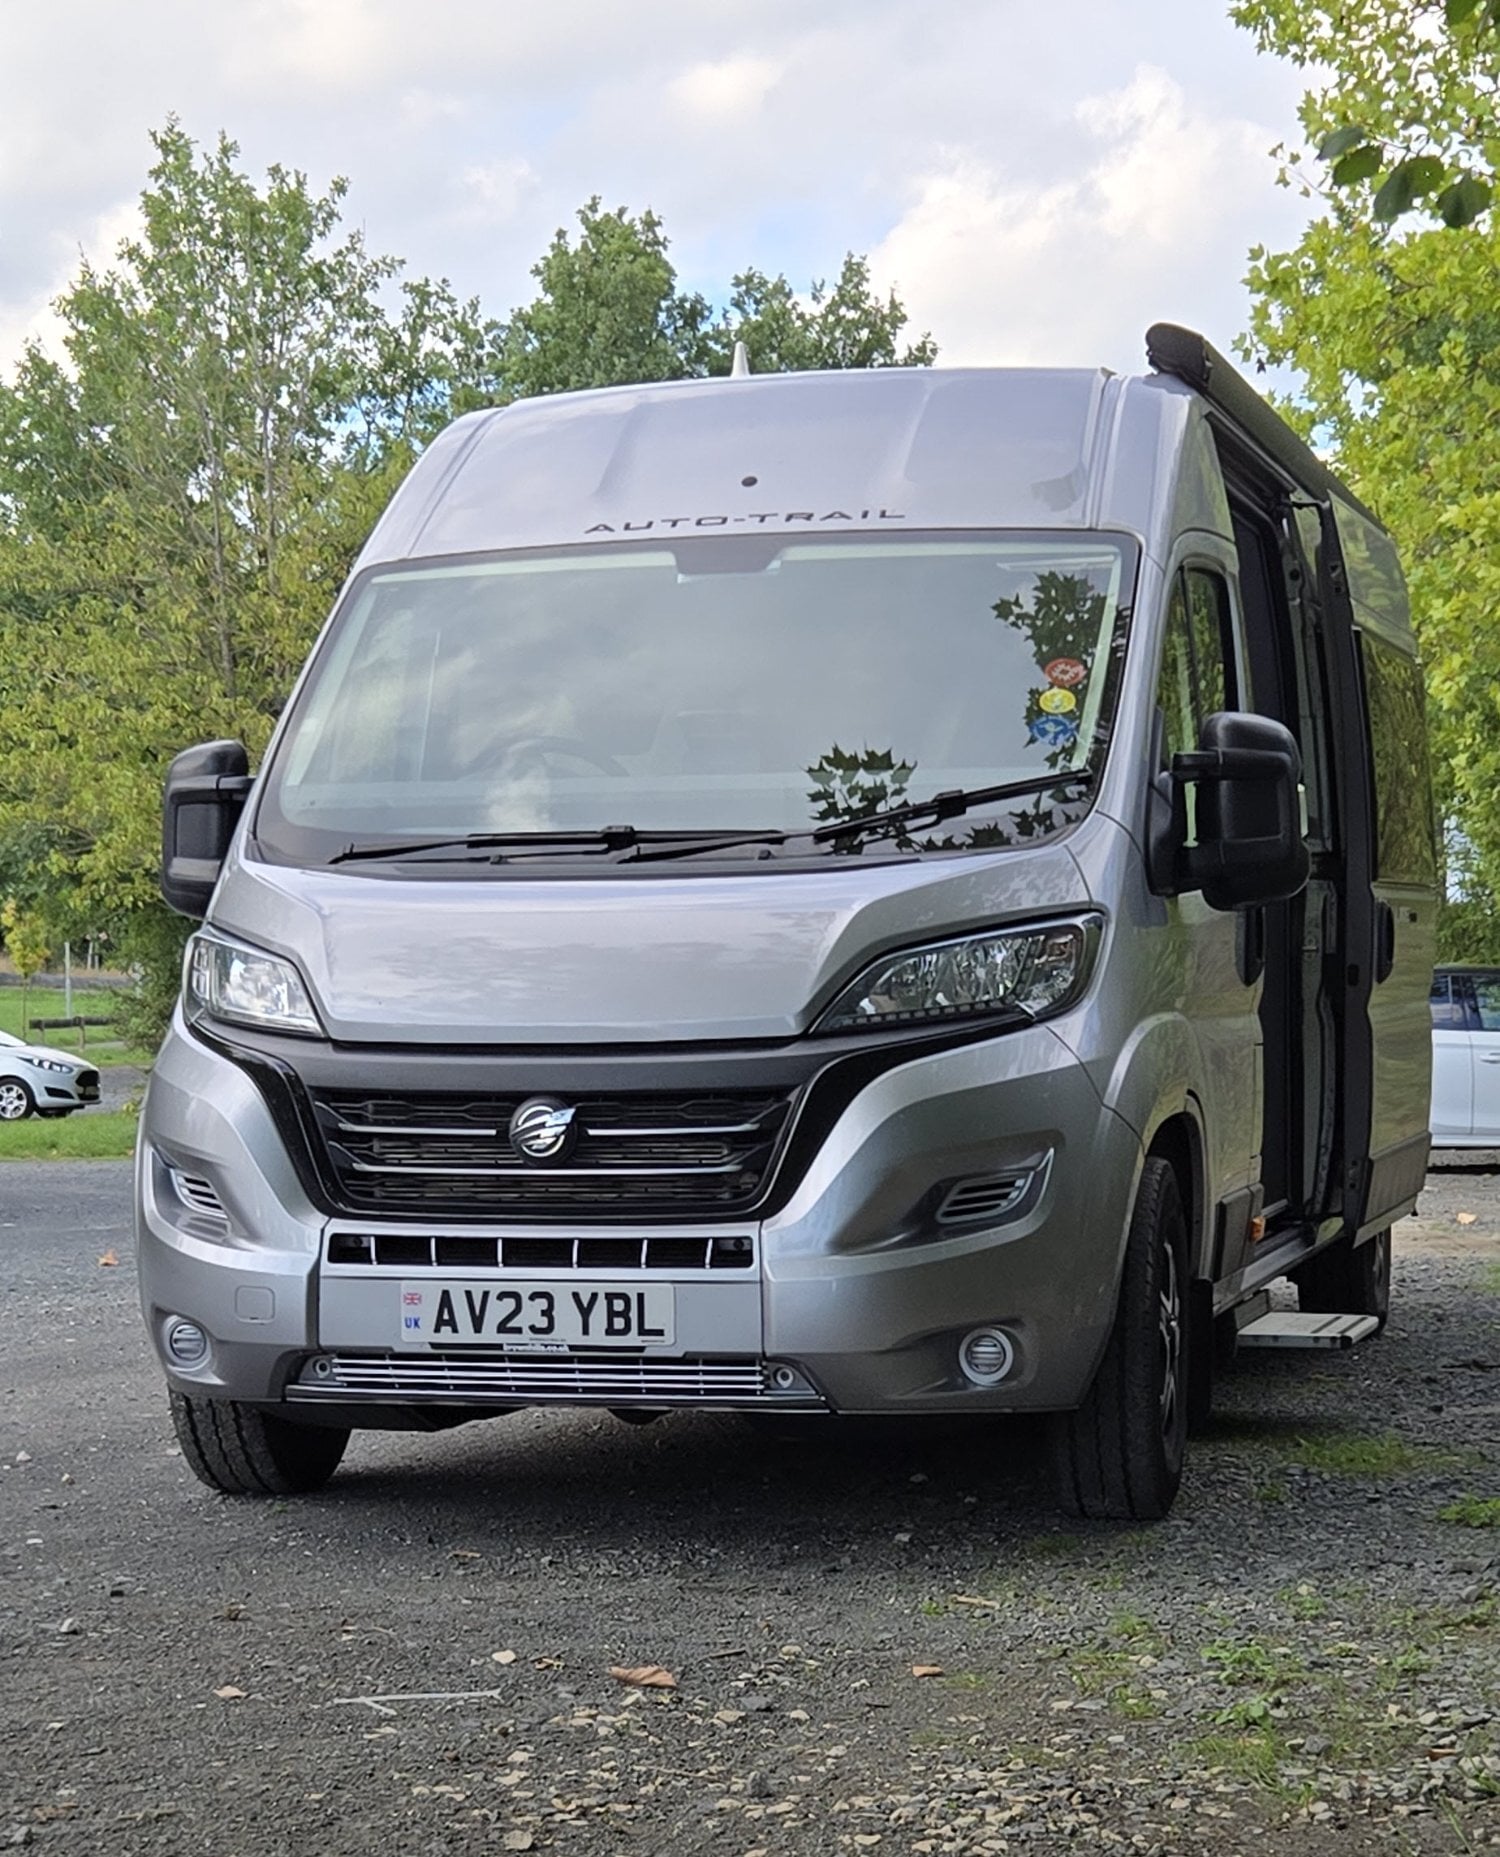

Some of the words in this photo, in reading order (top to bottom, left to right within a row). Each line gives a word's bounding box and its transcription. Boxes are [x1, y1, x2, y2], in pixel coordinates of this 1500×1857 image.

[584, 509, 905, 533] AUTO-TRAIL
[404, 1317, 421, 1329] UK
[433, 1289, 555, 1335] AV23
[571, 1291, 665, 1337] YBL
